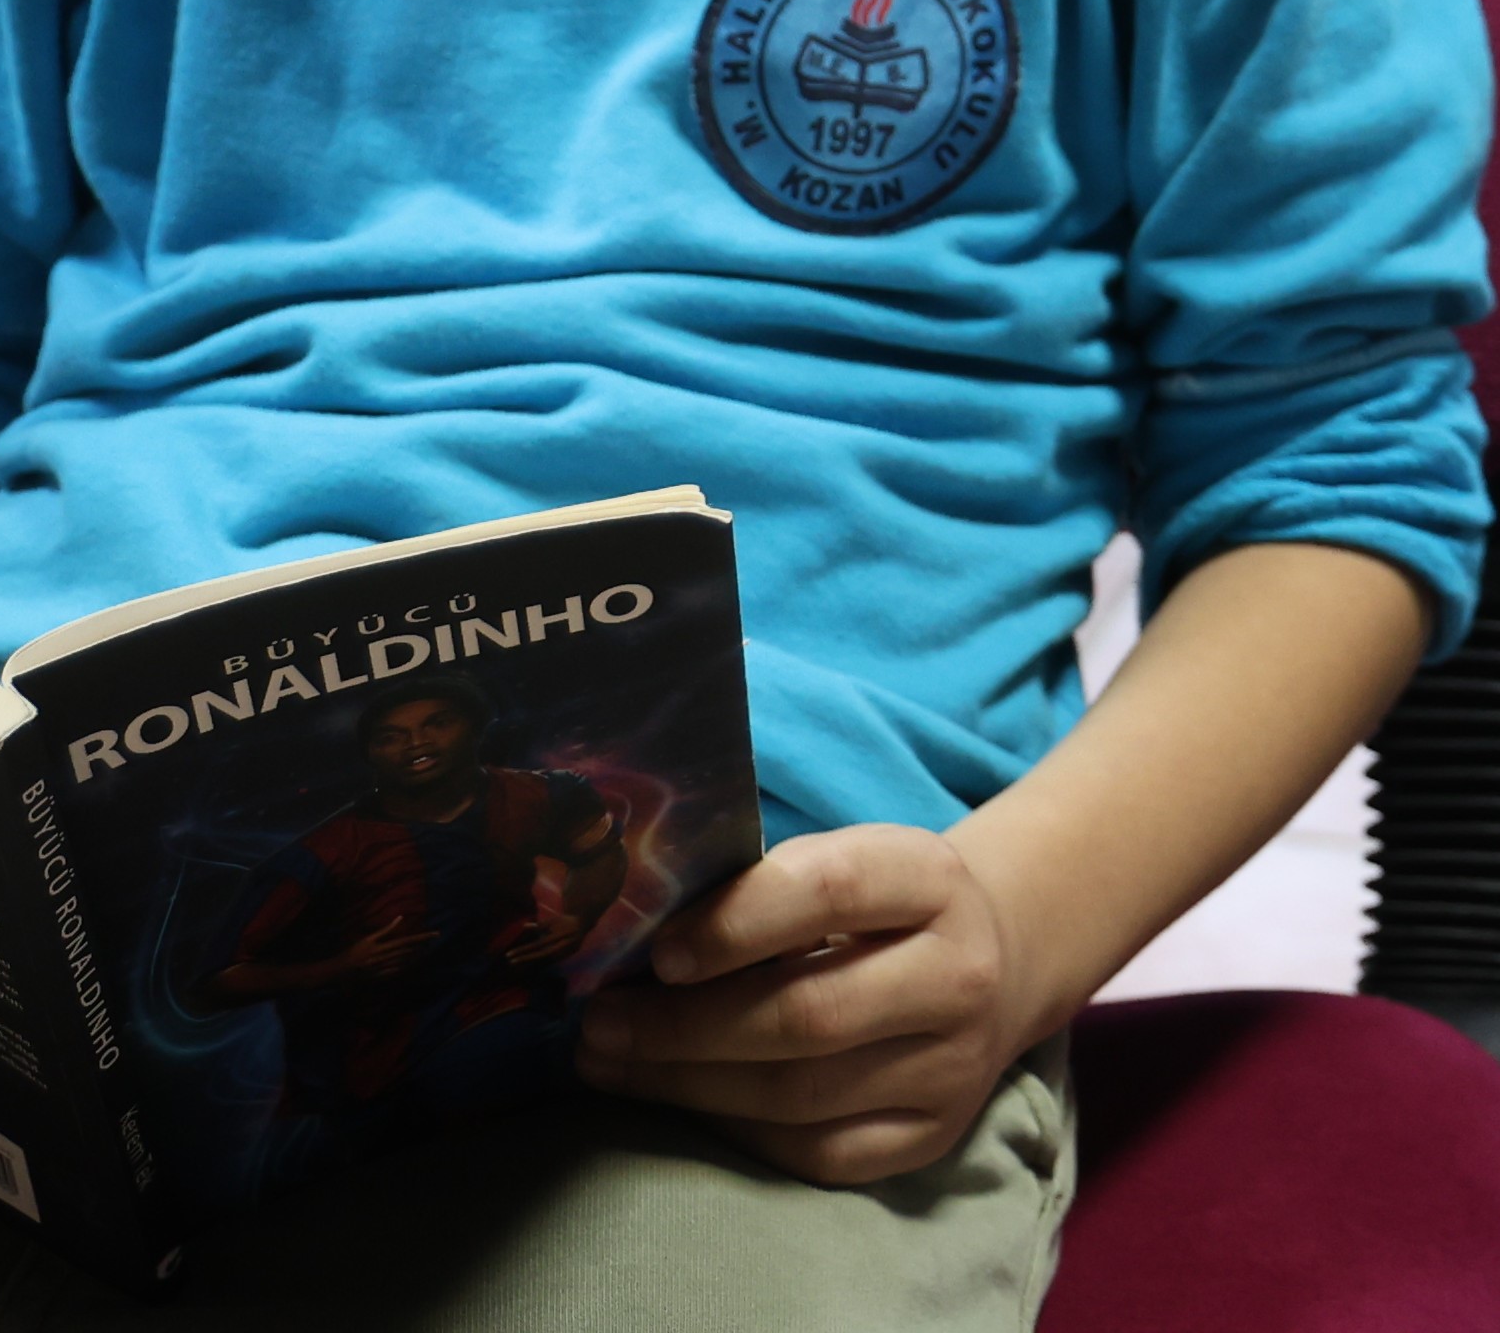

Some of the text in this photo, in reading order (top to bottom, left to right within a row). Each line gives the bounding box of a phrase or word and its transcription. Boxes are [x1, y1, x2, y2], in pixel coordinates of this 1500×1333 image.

[809, 116, 896, 159] 1997
[778, 165, 905, 212] KOZAN
[223, 593, 478, 676] BÜYÜCÜ
[67, 582, 655, 785] RONALDINHO
[21, 779, 121, 1070] BÜYÜCÜ RONALDINHO
